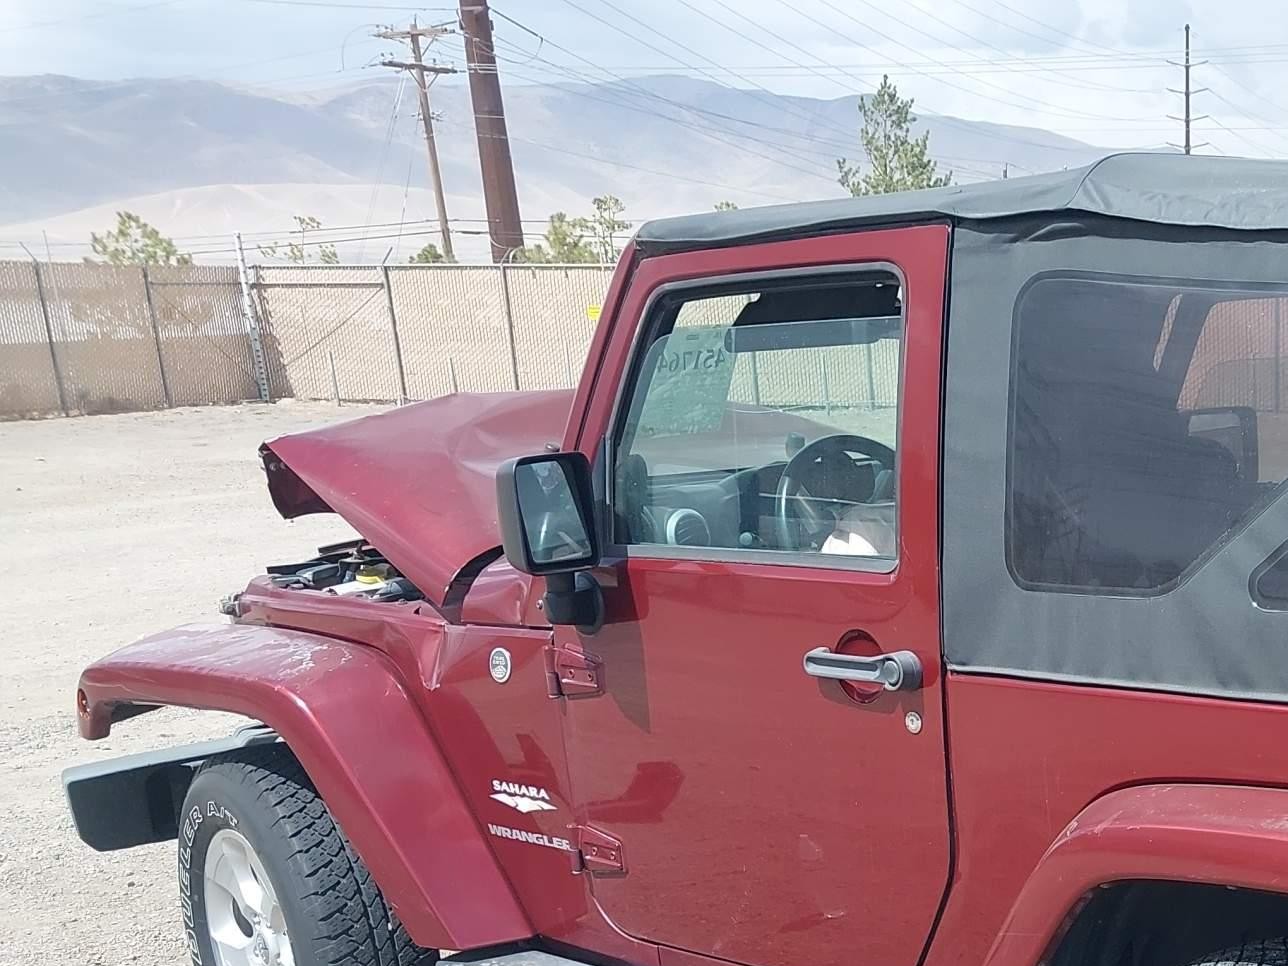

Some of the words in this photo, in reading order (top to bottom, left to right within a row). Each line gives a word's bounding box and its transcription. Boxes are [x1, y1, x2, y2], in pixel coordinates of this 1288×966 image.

[492, 779, 551, 801] SAHARA
[488, 823, 577, 851] WRANGLER
[180, 805, 204, 966] DUELER
[207, 801, 238, 828] A/T
